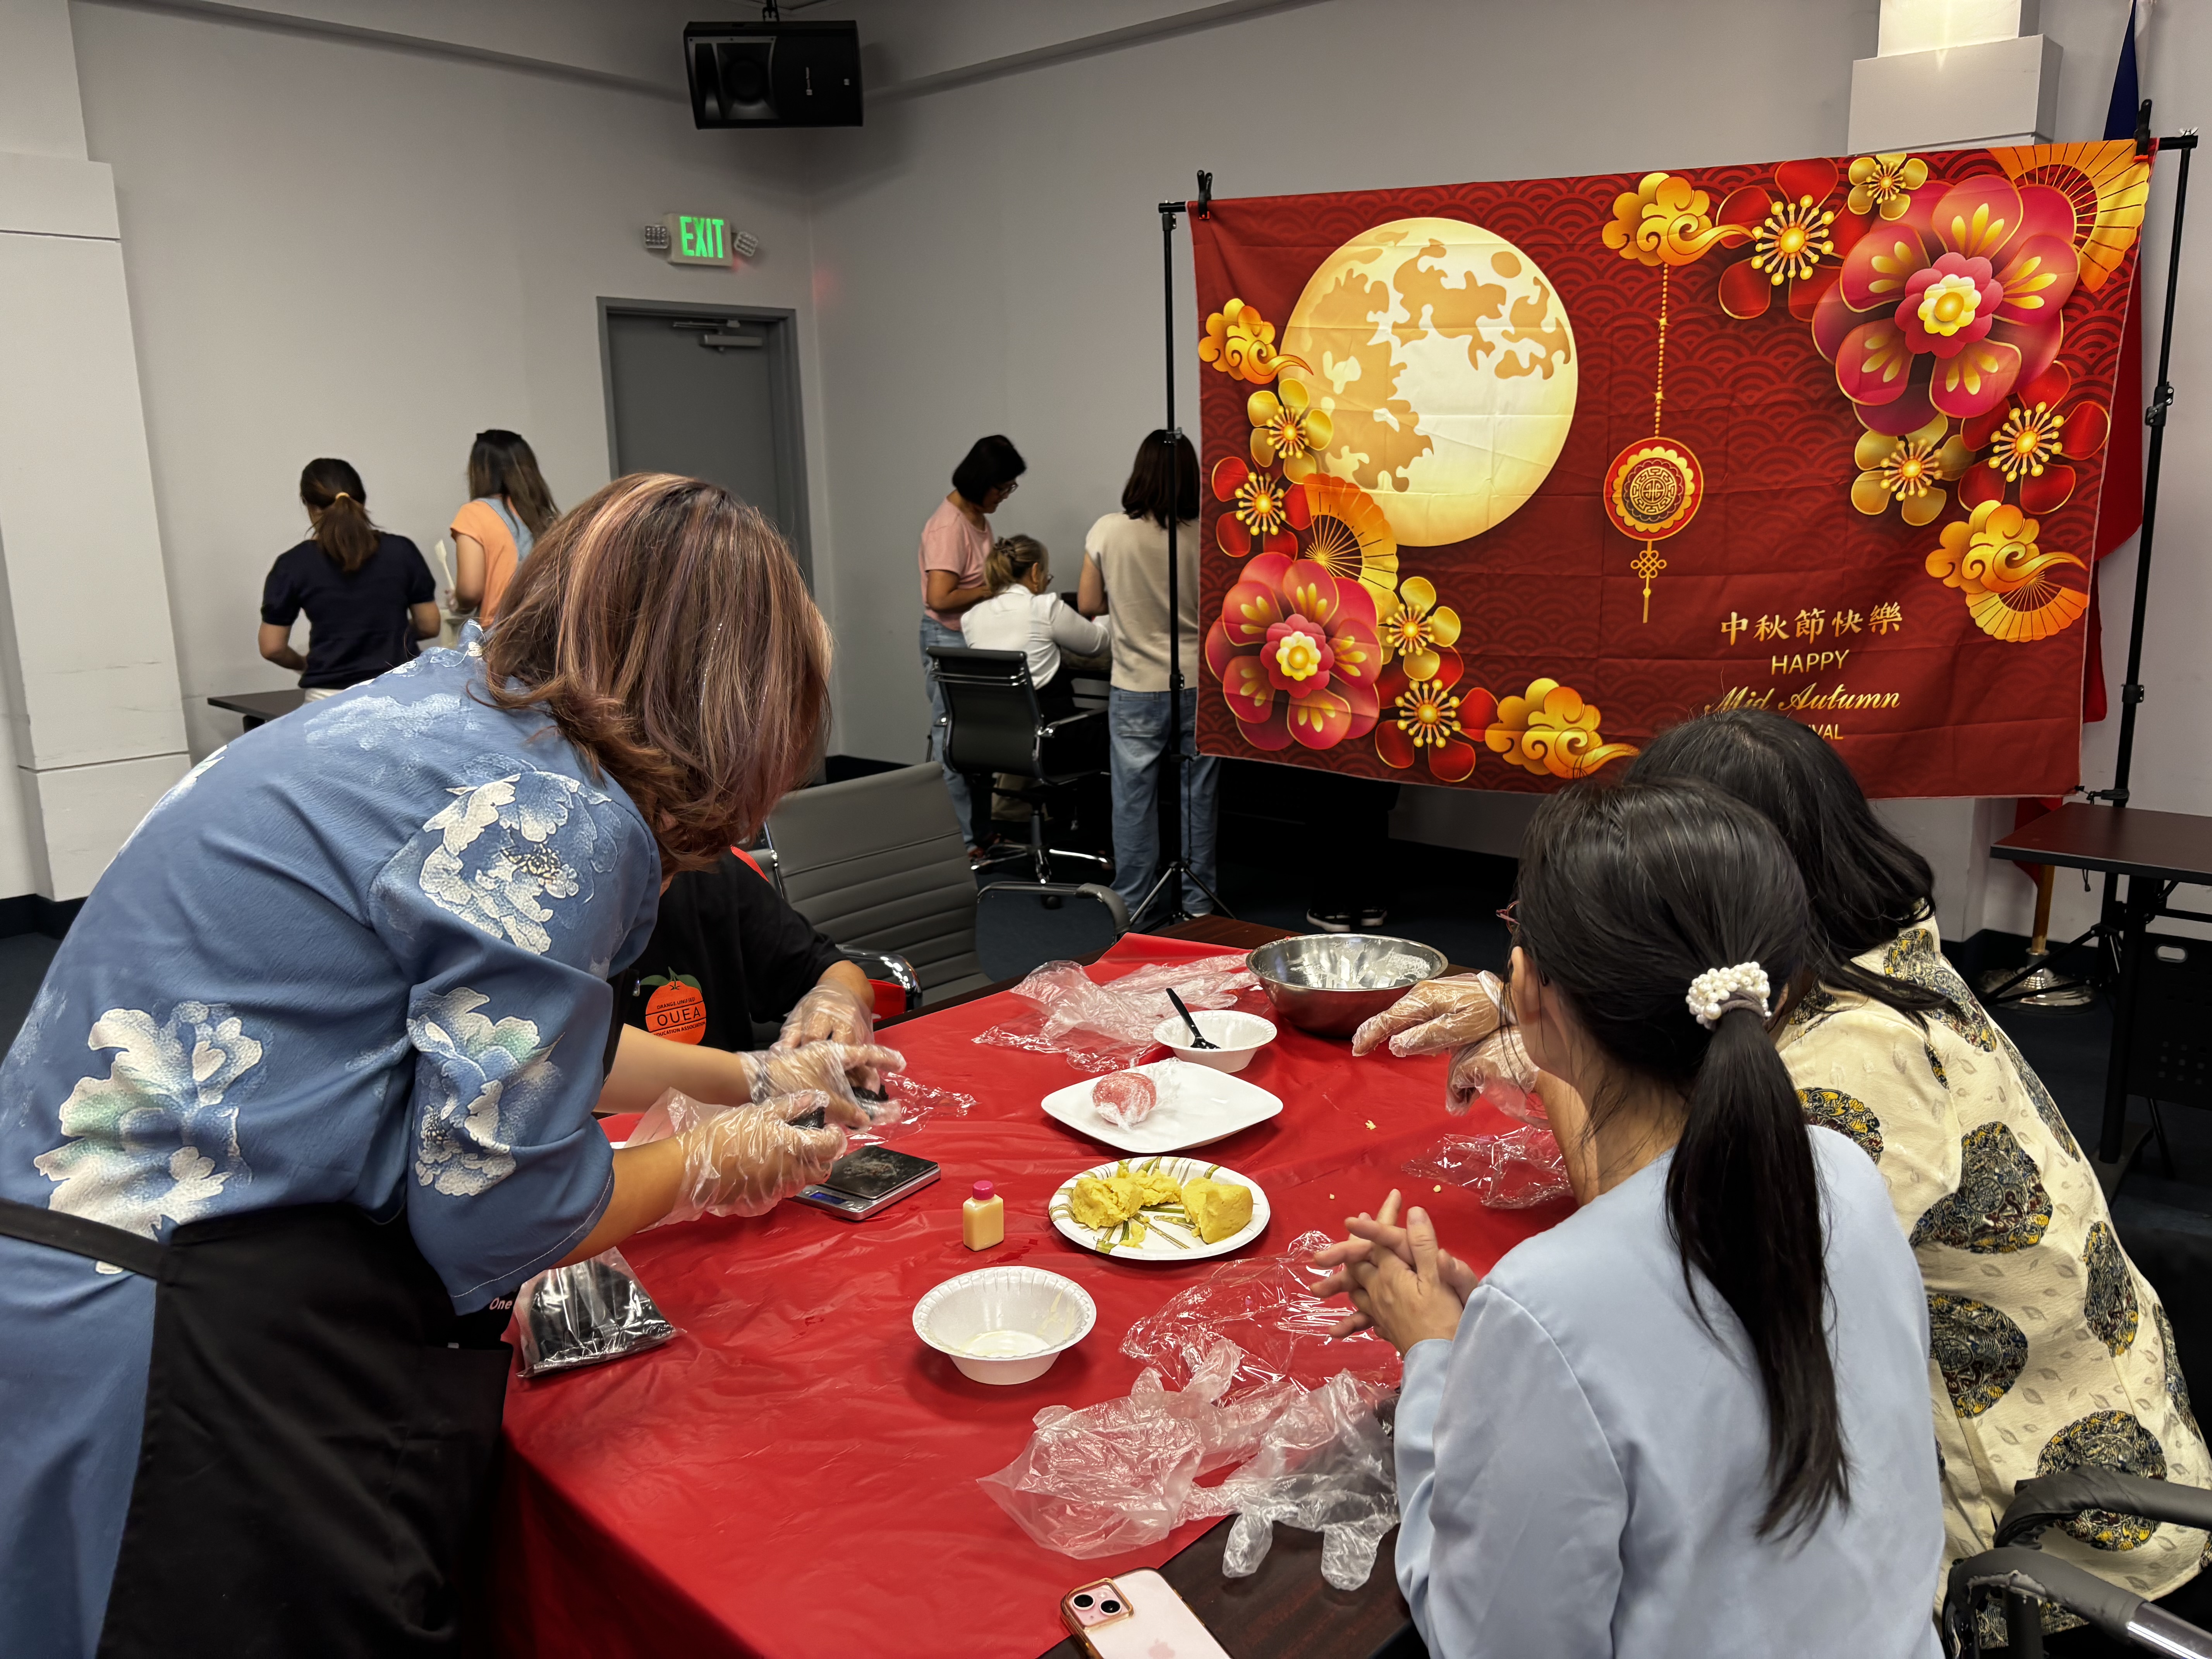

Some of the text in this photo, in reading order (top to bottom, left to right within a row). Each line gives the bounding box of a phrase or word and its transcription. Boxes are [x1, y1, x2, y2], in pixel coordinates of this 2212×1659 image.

[680, 216, 724, 258] EXIT
[1721, 601, 1903, 646] 中秋節快樂
[1771, 649, 1850, 675] HAPPY
[1704, 682, 1901, 714] Mid Autumn
[657, 1006, 701, 1026] OUEA
[489, 1297, 513, 1310] One
